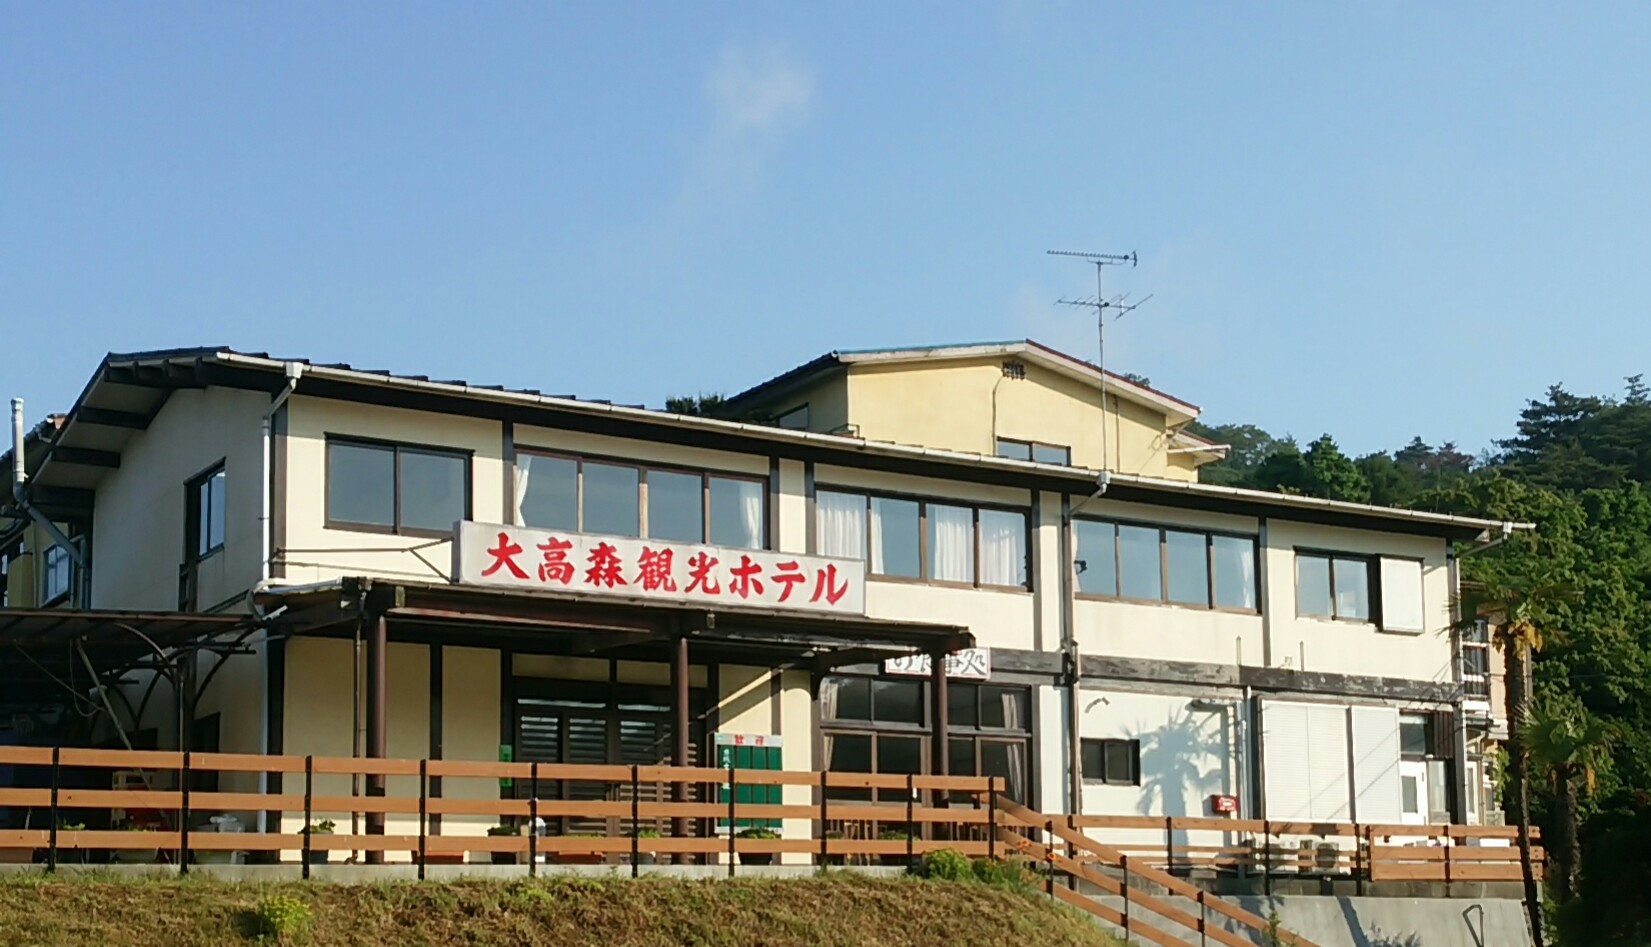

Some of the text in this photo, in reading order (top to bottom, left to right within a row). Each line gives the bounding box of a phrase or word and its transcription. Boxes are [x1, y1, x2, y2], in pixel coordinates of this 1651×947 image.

[481, 532, 849, 606] 大高森観光ホテル
